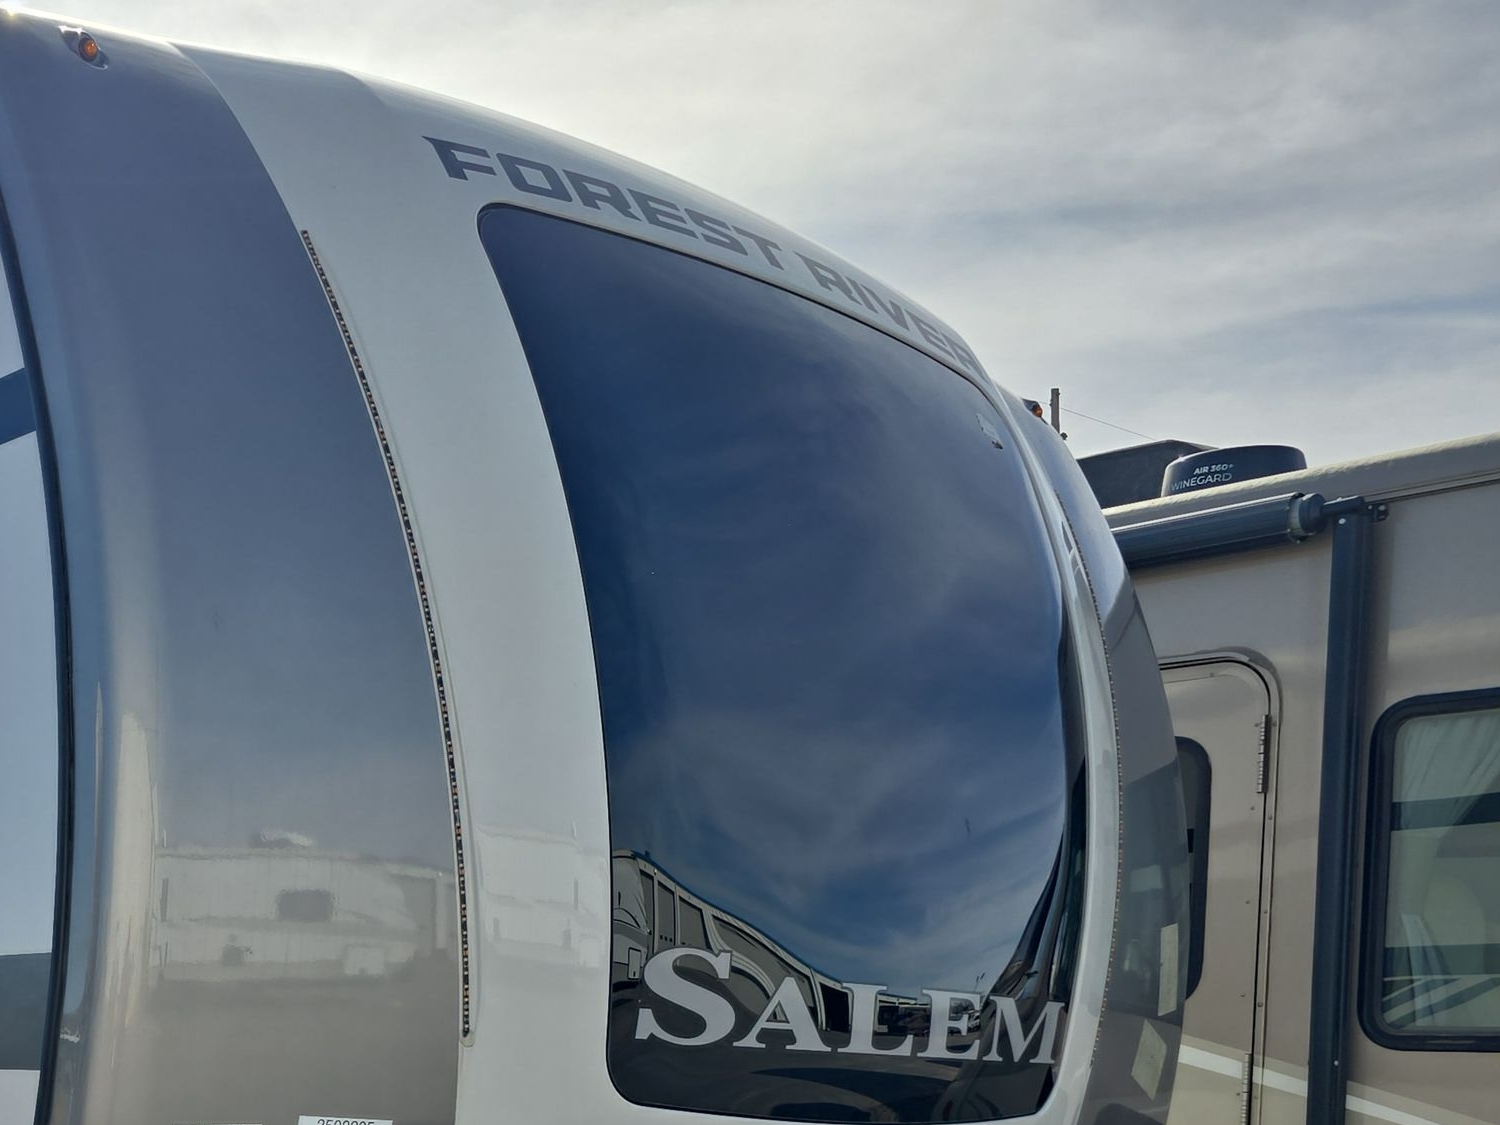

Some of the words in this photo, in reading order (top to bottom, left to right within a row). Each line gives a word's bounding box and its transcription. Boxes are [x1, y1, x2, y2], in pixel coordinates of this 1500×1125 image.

[422, 135, 786, 271] FOREST
[794, 250, 990, 385] RIVER
[1171, 473, 1232, 491] WINEGARD
[1193, 466, 1209, 475] AIR
[635, 946, 1066, 1065] SALEM
